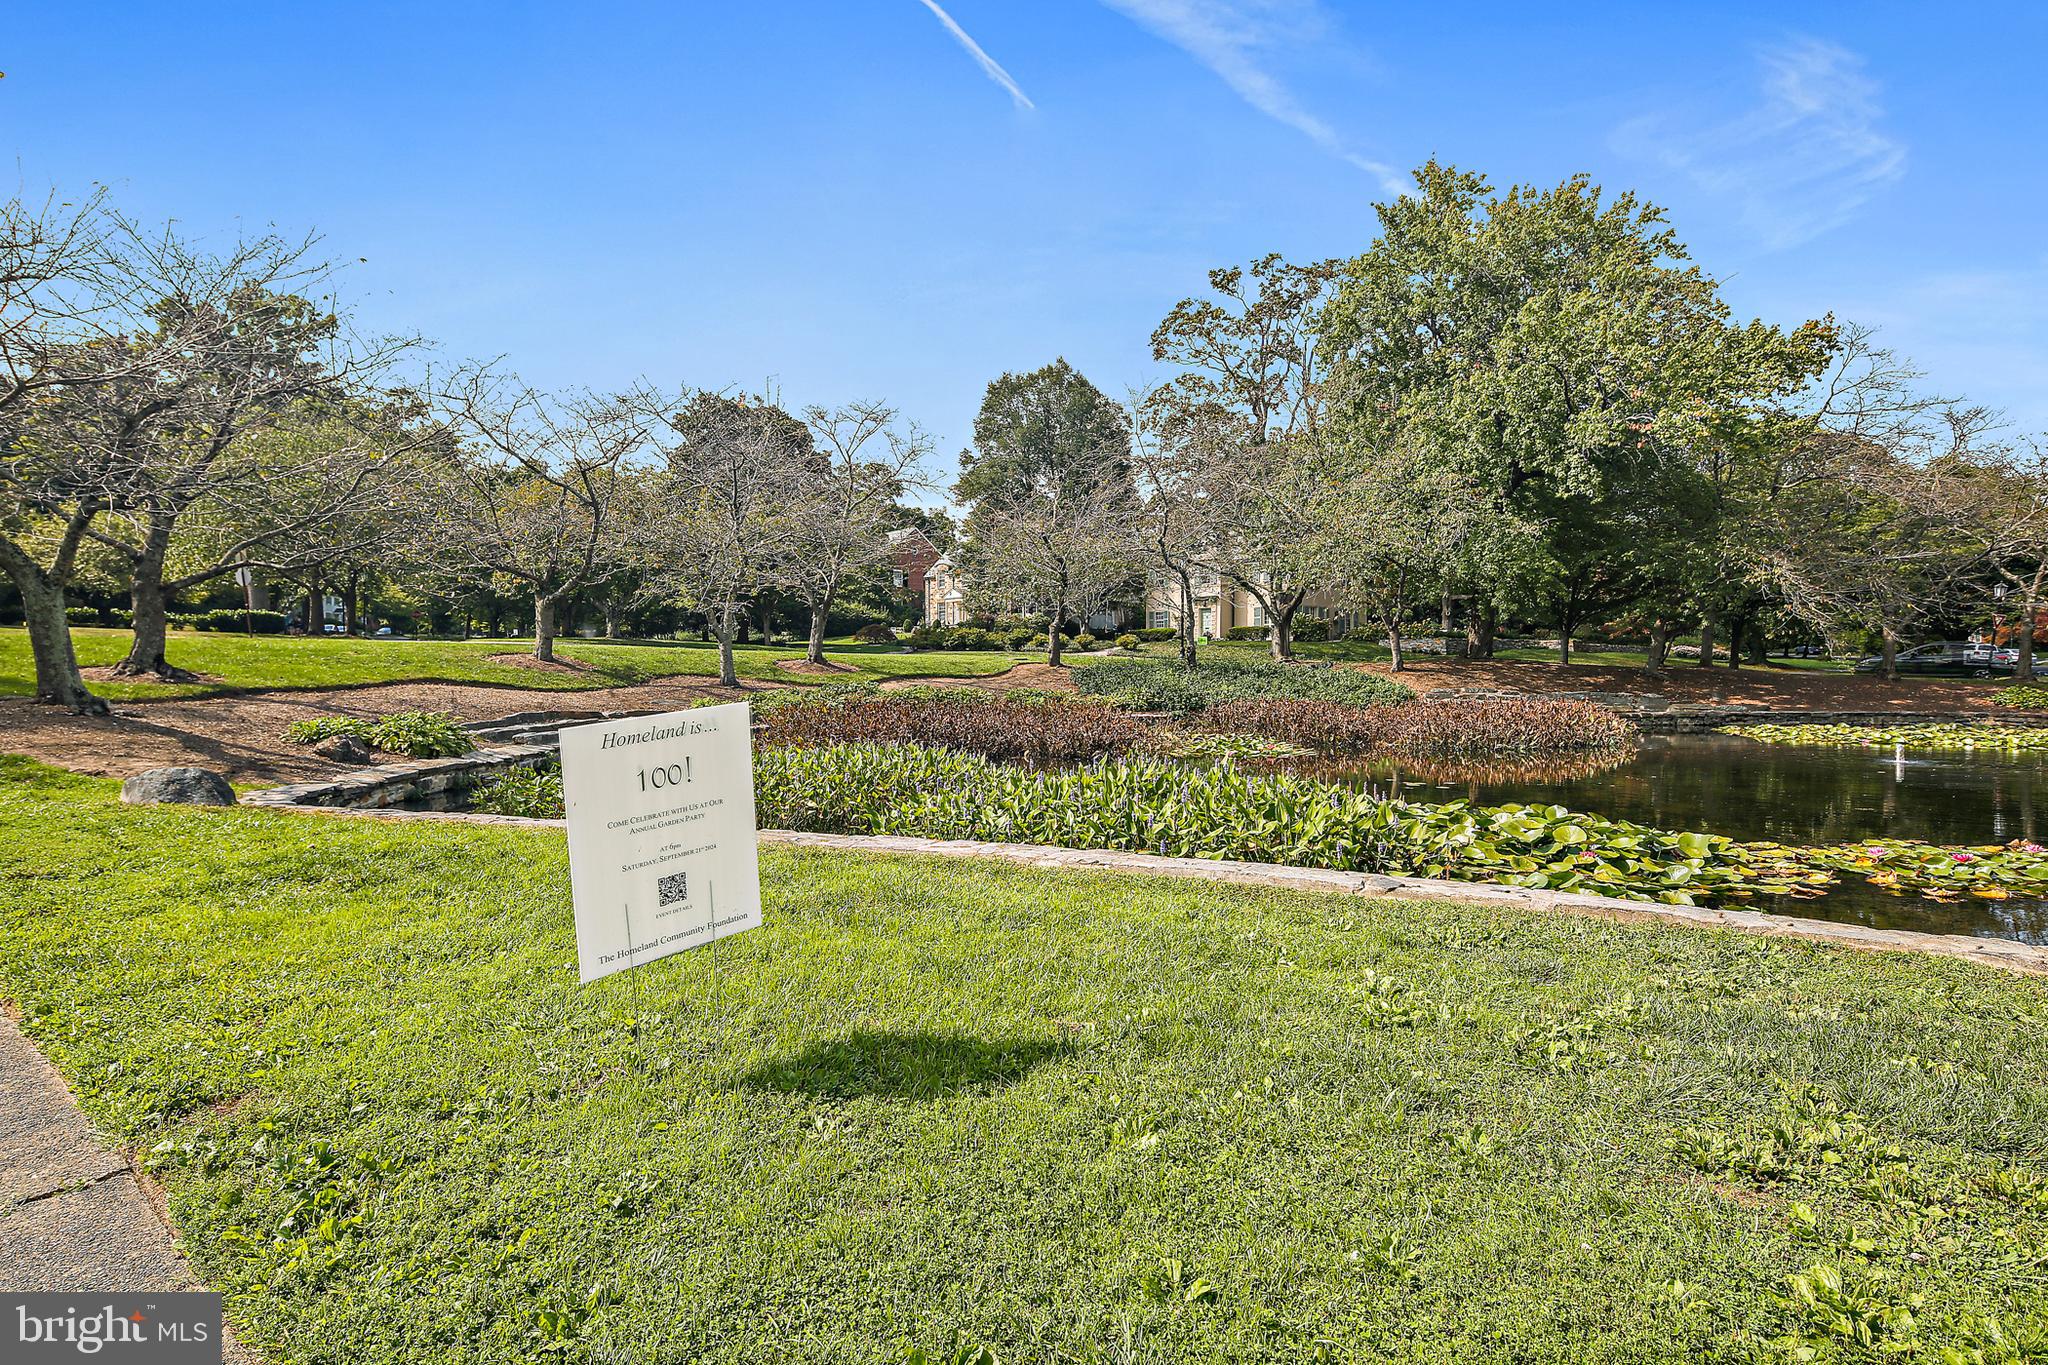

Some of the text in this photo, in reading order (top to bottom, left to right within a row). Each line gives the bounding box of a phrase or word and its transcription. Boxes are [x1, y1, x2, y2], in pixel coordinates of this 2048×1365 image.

[601, 721, 686, 749] Homeland
[637, 756, 692, 791] 100!
[705, 844, 717, 852] 2024
[598, 912, 748, 965] The Homeland Community Foundation
